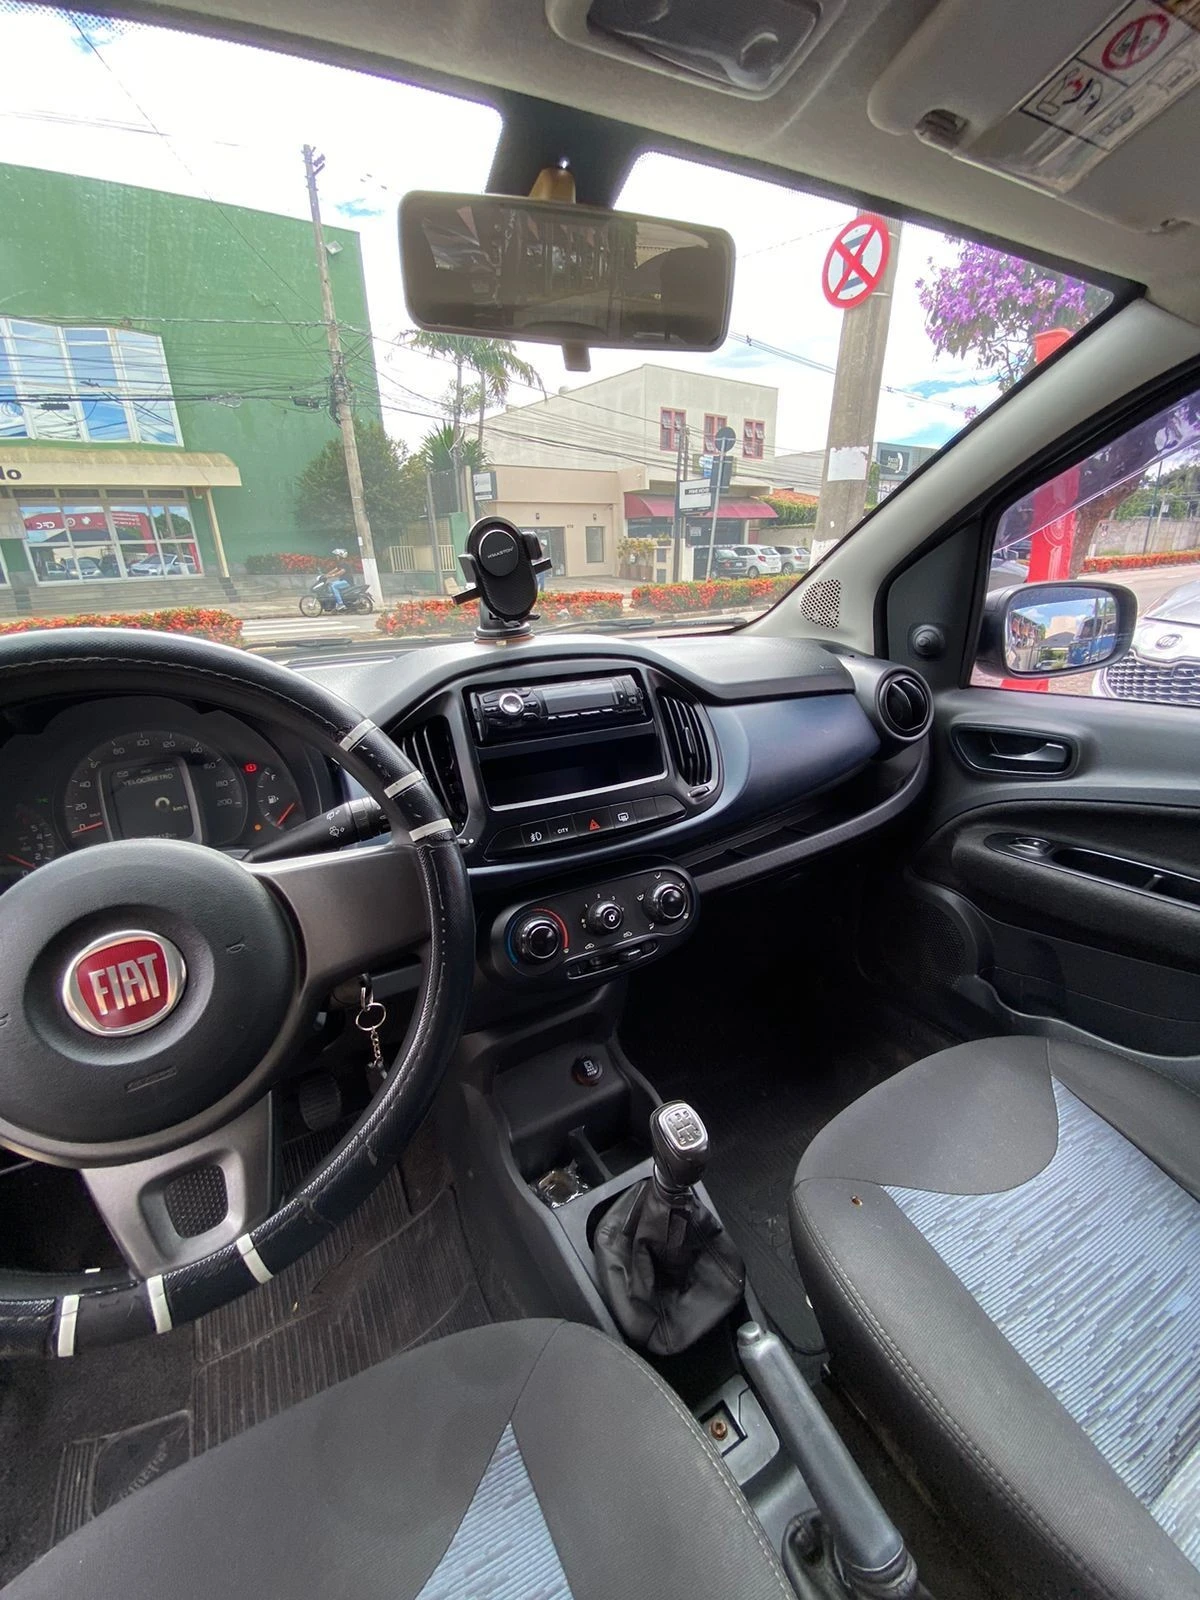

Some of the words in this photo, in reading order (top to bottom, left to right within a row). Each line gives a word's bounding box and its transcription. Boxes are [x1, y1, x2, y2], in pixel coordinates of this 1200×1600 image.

[75, 802, 87, 811] 20
[217, 798, 232, 806] 200
[88, 953, 160, 1016] FIAT
